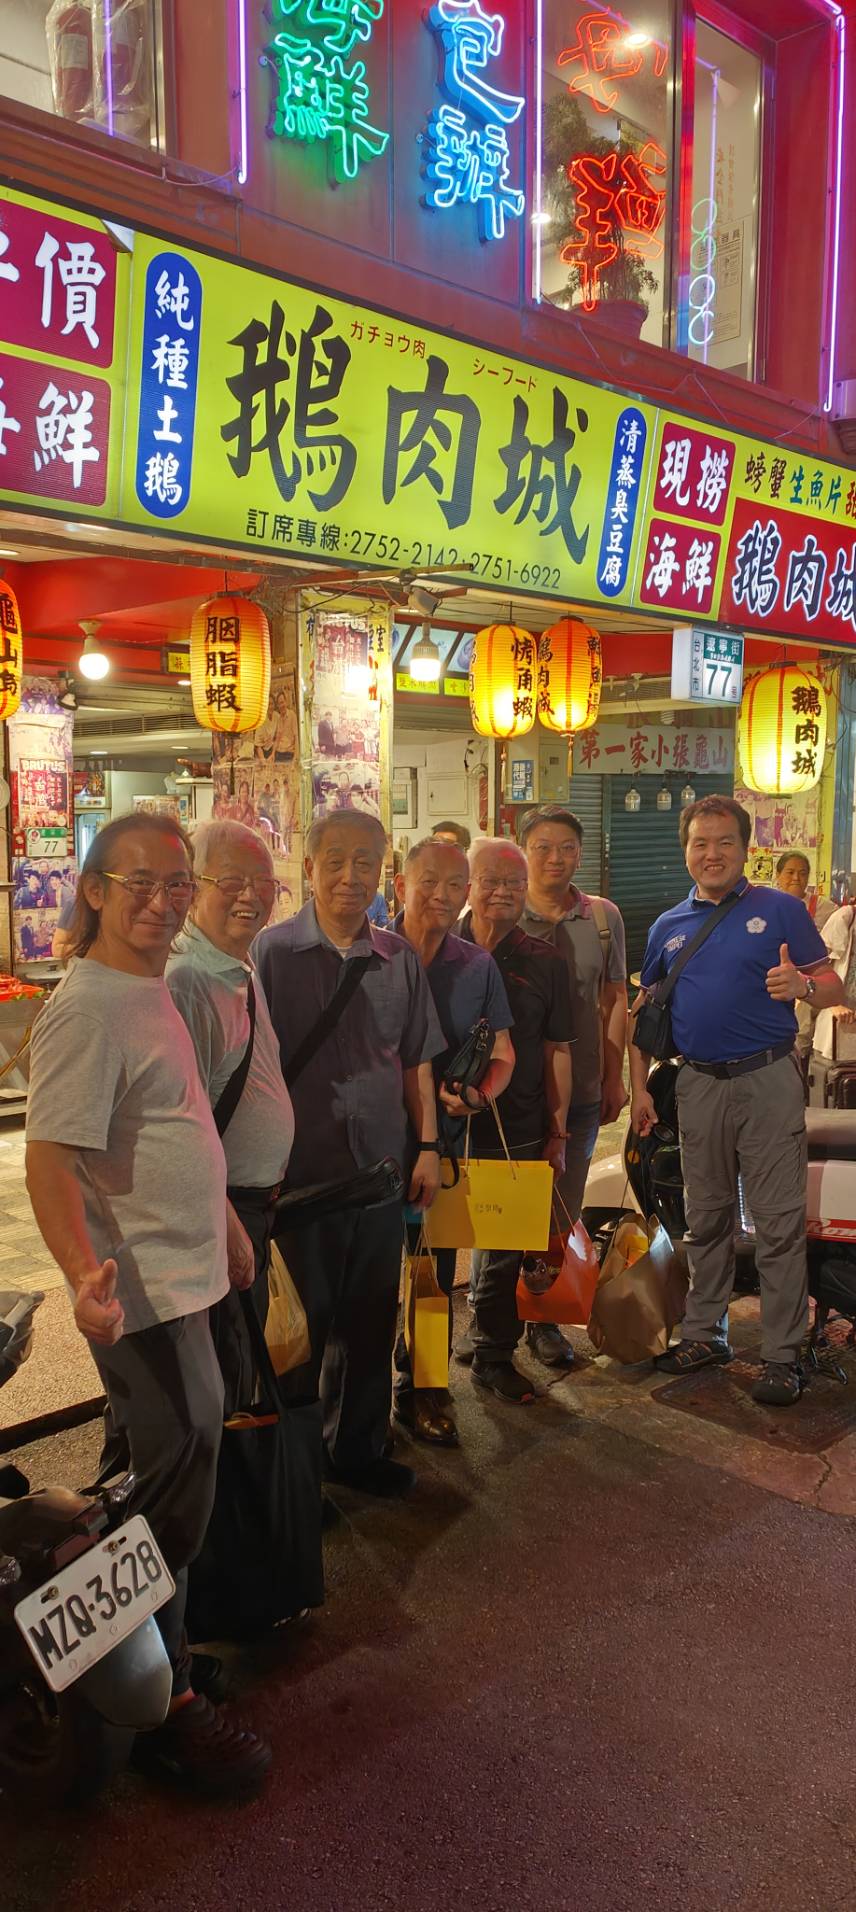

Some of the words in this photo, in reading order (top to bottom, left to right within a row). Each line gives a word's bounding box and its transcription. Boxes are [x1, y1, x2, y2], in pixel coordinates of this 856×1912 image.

[350, 320, 427, 359] ガチョウ肉
[473, 357, 537, 393] シーフード
[144, 270, 194, 505] 純種土鵝
[220, 299, 591, 565] 鵝肉城
[600, 420, 642, 588] 清蒸臭豆腐
[660, 438, 729, 514] 現撈
[645, 532, 715, 604] 海鮮
[205, 616, 243, 713] 胭脂蝦
[706, 663, 732, 697] 77
[790, 685, 822, 778] 鵝肉城
[43, 841, 58, 854] 77
[28, 1540, 163, 1670] MZQ-3628
